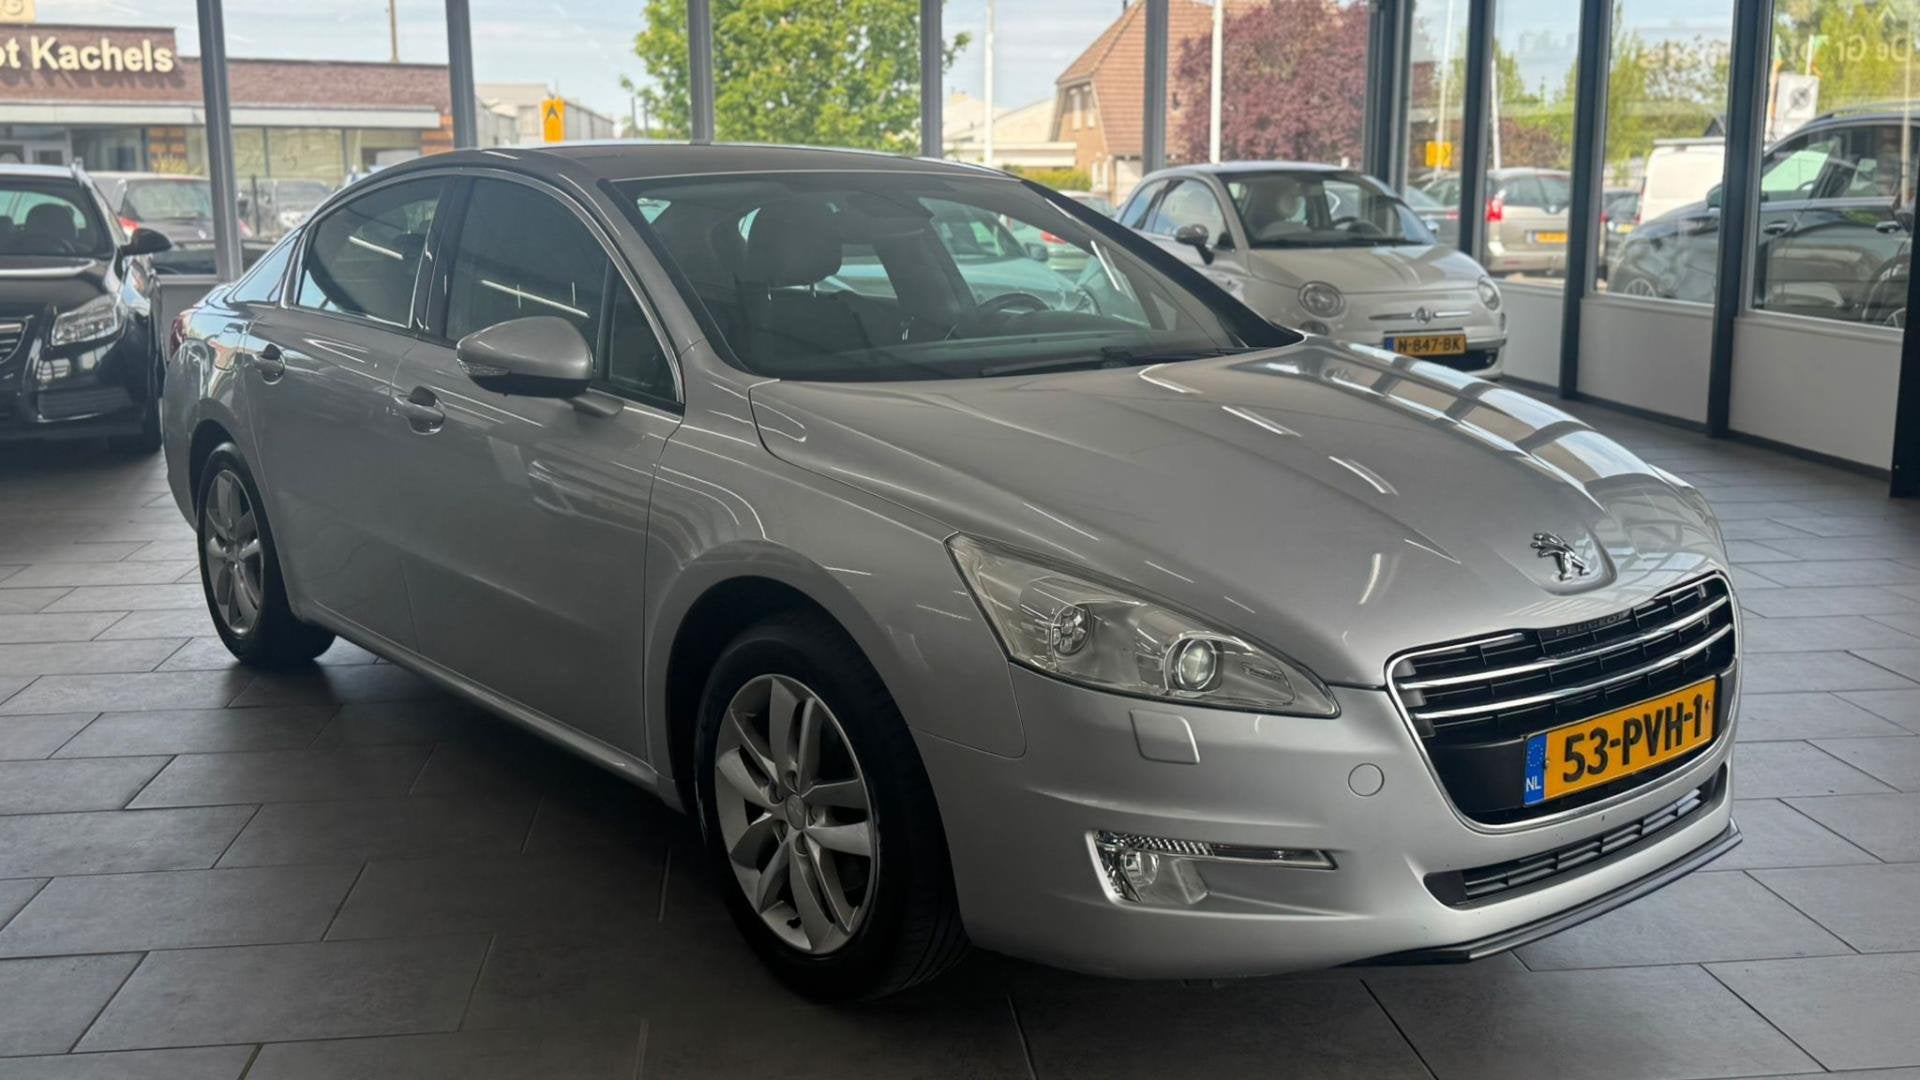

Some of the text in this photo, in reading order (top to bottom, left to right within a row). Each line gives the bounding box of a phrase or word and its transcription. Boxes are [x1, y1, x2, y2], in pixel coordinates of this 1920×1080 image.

[30, 36, 174, 72] Kachels
[1562, 694, 1703, 783] 53-PVH-1
[1525, 776, 1542, 792] NL
